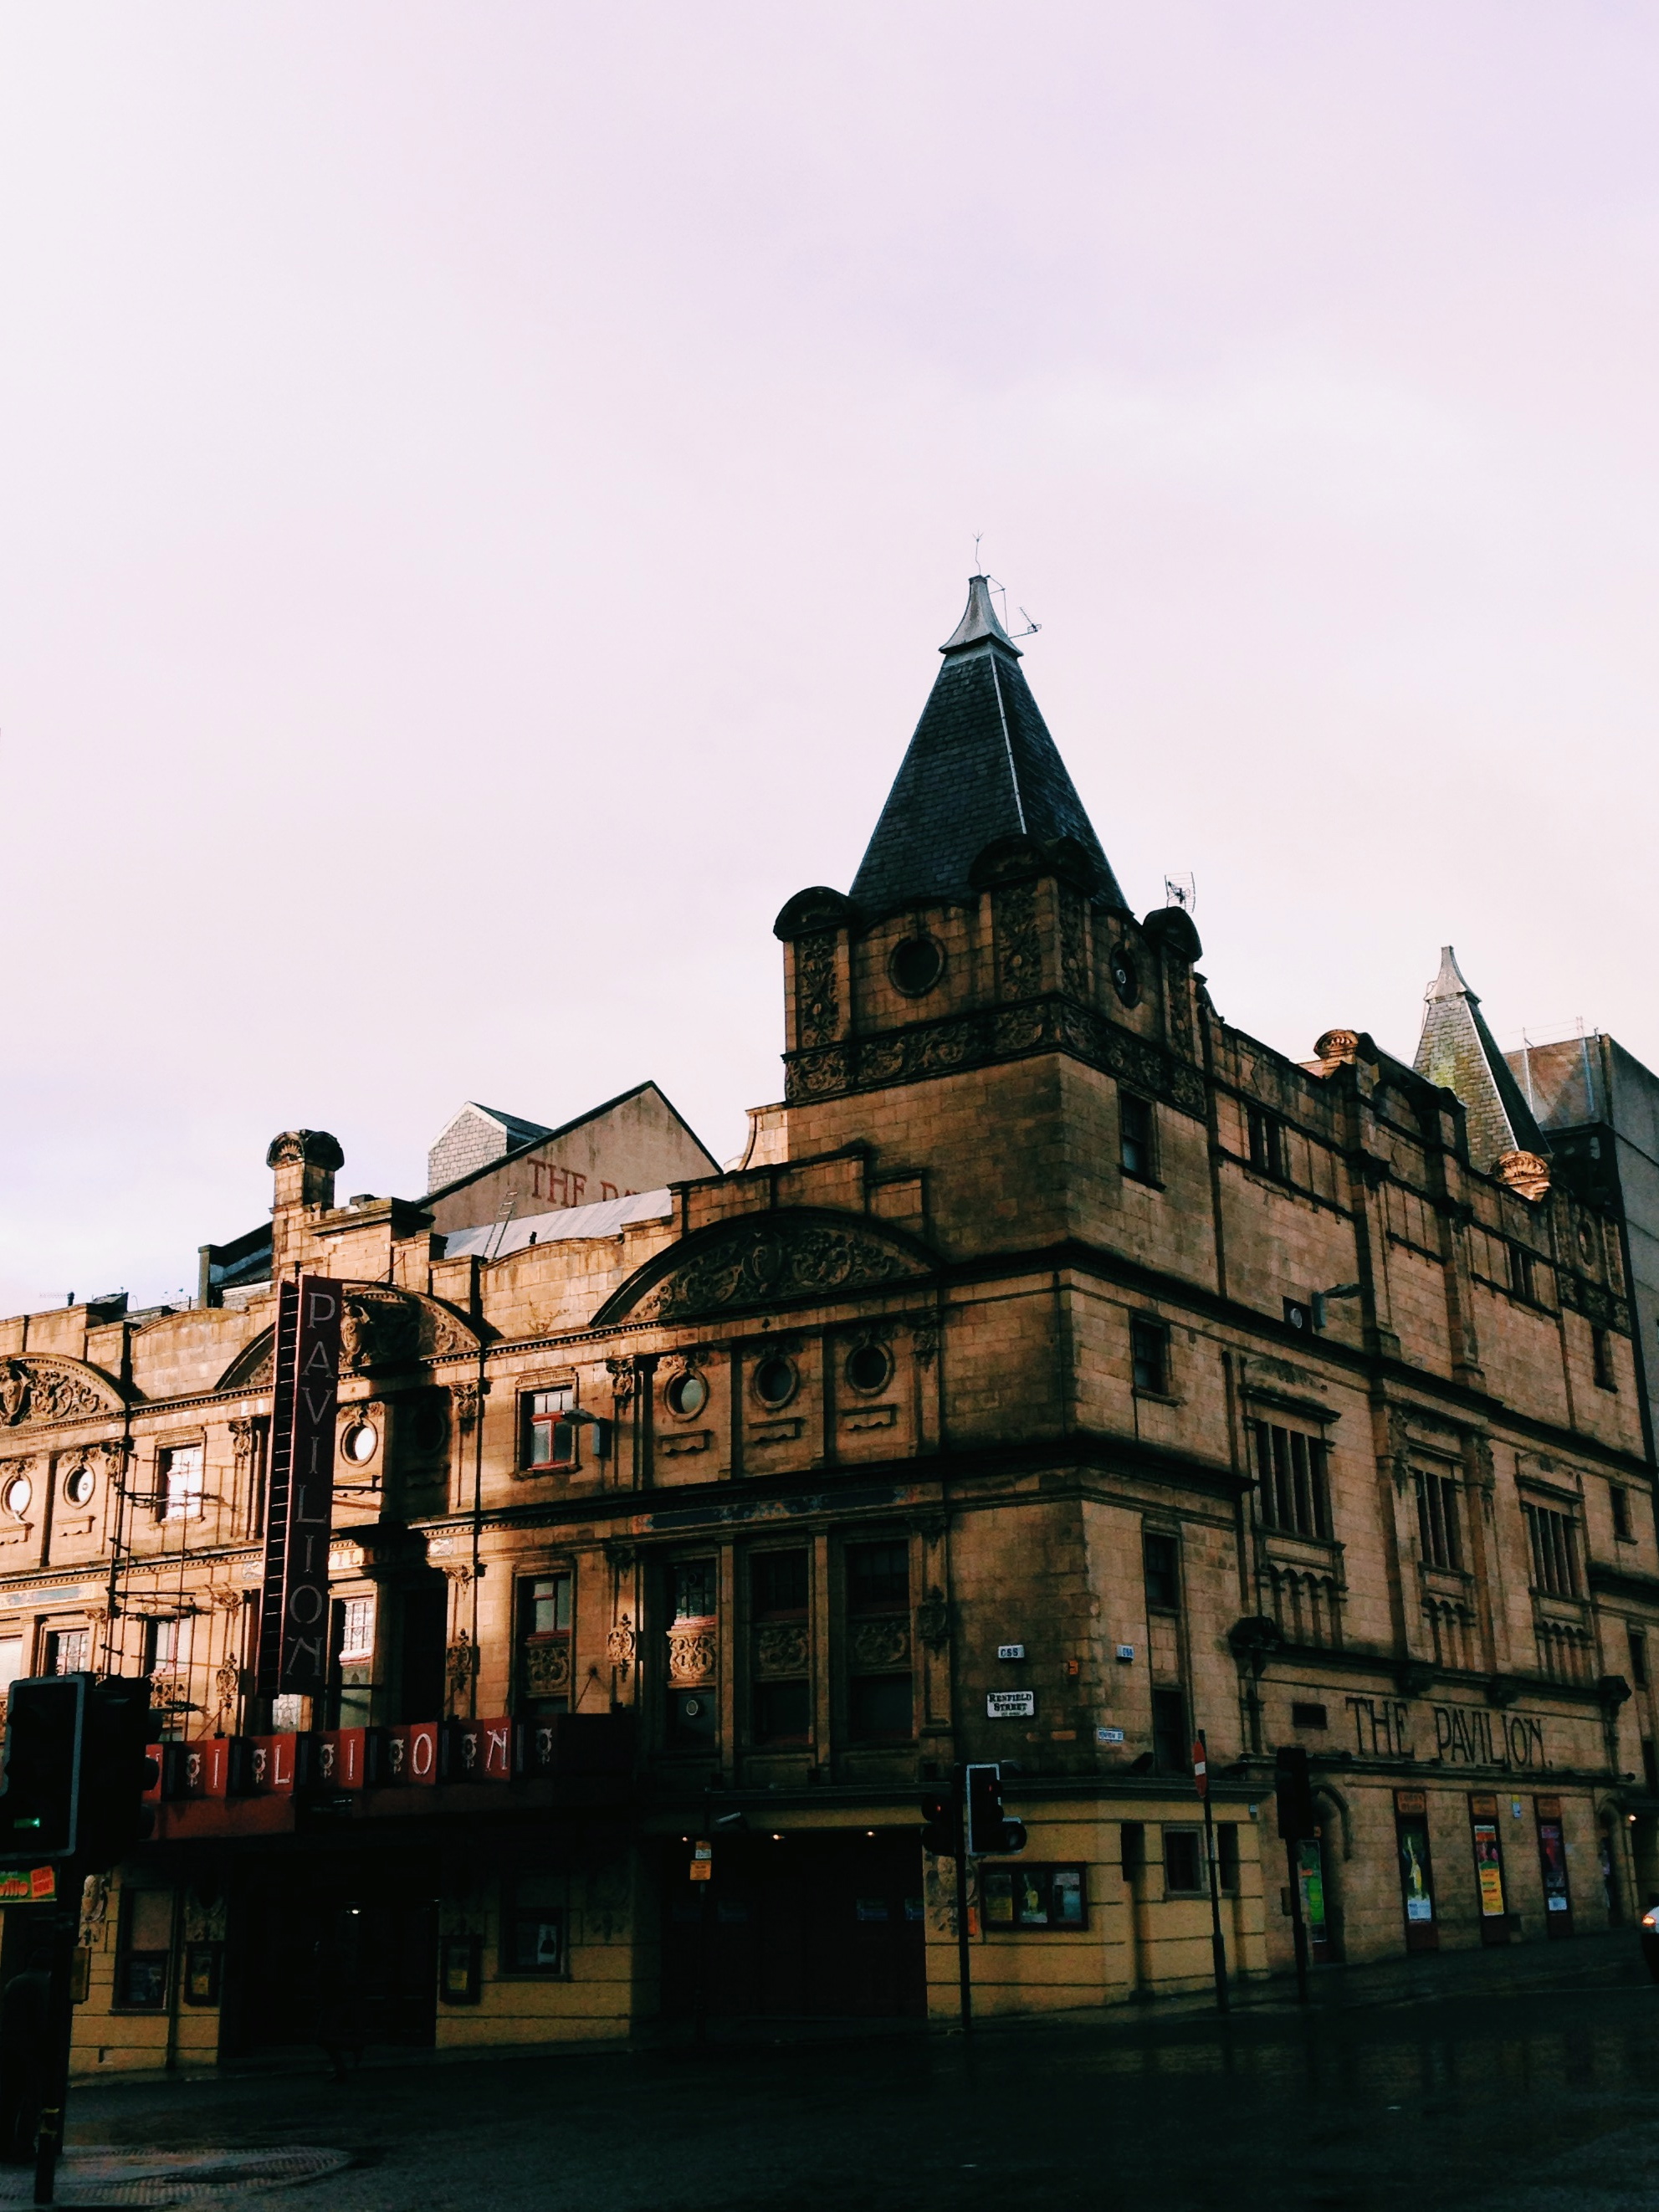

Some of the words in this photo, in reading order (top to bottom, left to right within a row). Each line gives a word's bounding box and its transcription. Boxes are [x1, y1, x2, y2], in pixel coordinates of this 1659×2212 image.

[287, 1291, 335, 1676] PAVILION
[989, 1692, 1032, 1703] RENFIELD
[993, 1703, 1028, 1712] STREET
[1345, 1697, 1415, 1759] THE
